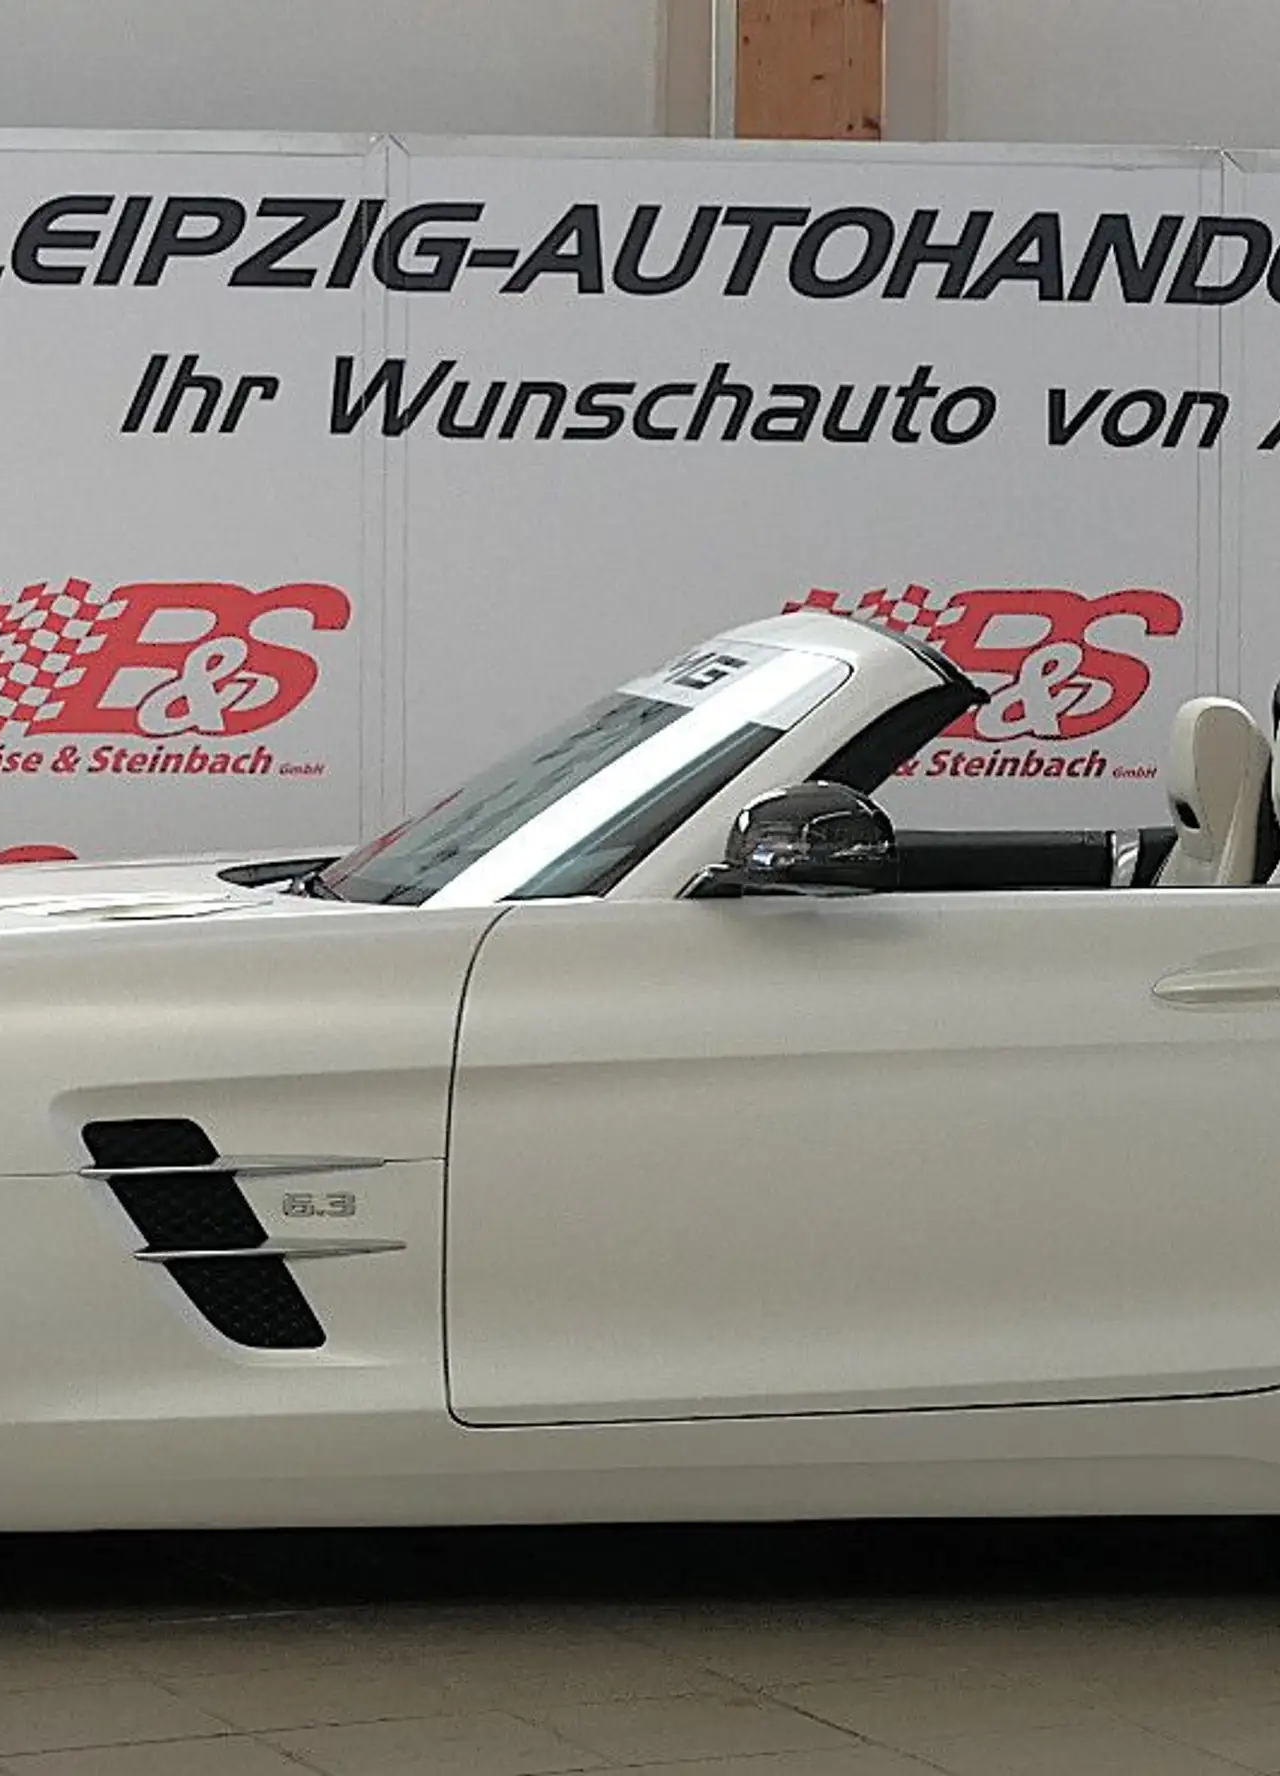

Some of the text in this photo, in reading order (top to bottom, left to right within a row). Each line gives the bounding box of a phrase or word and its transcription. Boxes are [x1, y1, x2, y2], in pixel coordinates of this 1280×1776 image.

[120, 353, 280, 434] Ihr
[329, 355, 997, 447] Wunschauto
[1047, 387, 1230, 451] von
[26, 580, 353, 741] B&S
[50, 745, 82, 775] &
[86, 744, 273, 776] Steinbach
[280, 763, 325, 776] GmbH
[926, 748, 1108, 779] Steinbach
[1112, 766, 1158, 780] GmbH
[282, 1191, 357, 1218] 6.3
